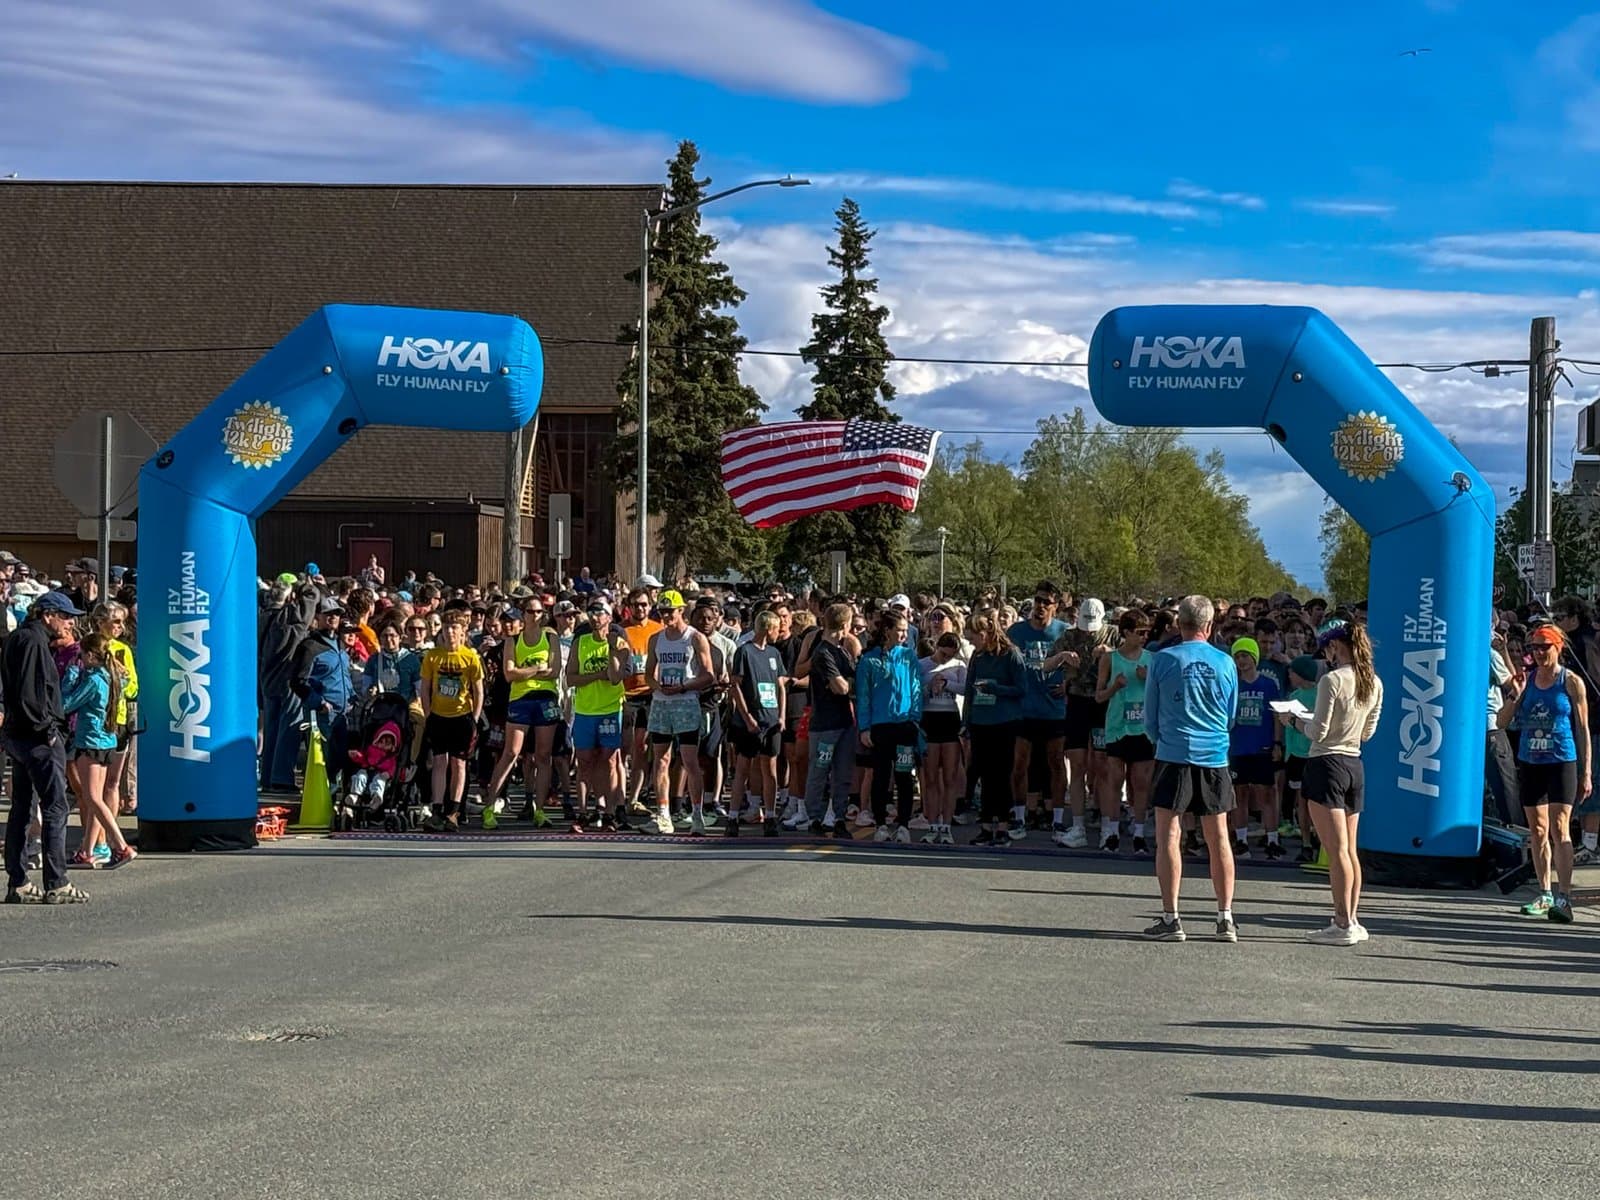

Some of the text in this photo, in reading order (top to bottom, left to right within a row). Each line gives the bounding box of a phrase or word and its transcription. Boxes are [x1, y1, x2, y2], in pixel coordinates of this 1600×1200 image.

[376, 336, 490, 373] HOKA
[1130, 336, 1245, 369] HOKA
[376, 375, 488, 393] FLY HUMAN FLY
[1129, 376, 1244, 390] FLY HUMAN FLY
[223, 430, 249, 448] 12k
[272, 437, 294, 452] 6k
[224, 415, 294, 441] Twilight
[1330, 428, 1404, 451] Twilight
[1332, 444, 1361, 462] 12k
[1383, 446, 1405, 462] 6k
[1520, 546, 1535, 556] ONE
[182, 551, 195, 615] HUMAN
[168, 587, 181, 615] FLY
[196, 586, 209, 615] FLY
[1418, 577, 1434, 644] HUMAN
[1403, 614, 1417, 642] FLY
[1433, 616, 1447, 644] FLY
[169, 619, 211, 763] HOKA
[1398, 647, 1447, 797] HOKA
[1529, 738, 1548, 750] 270
